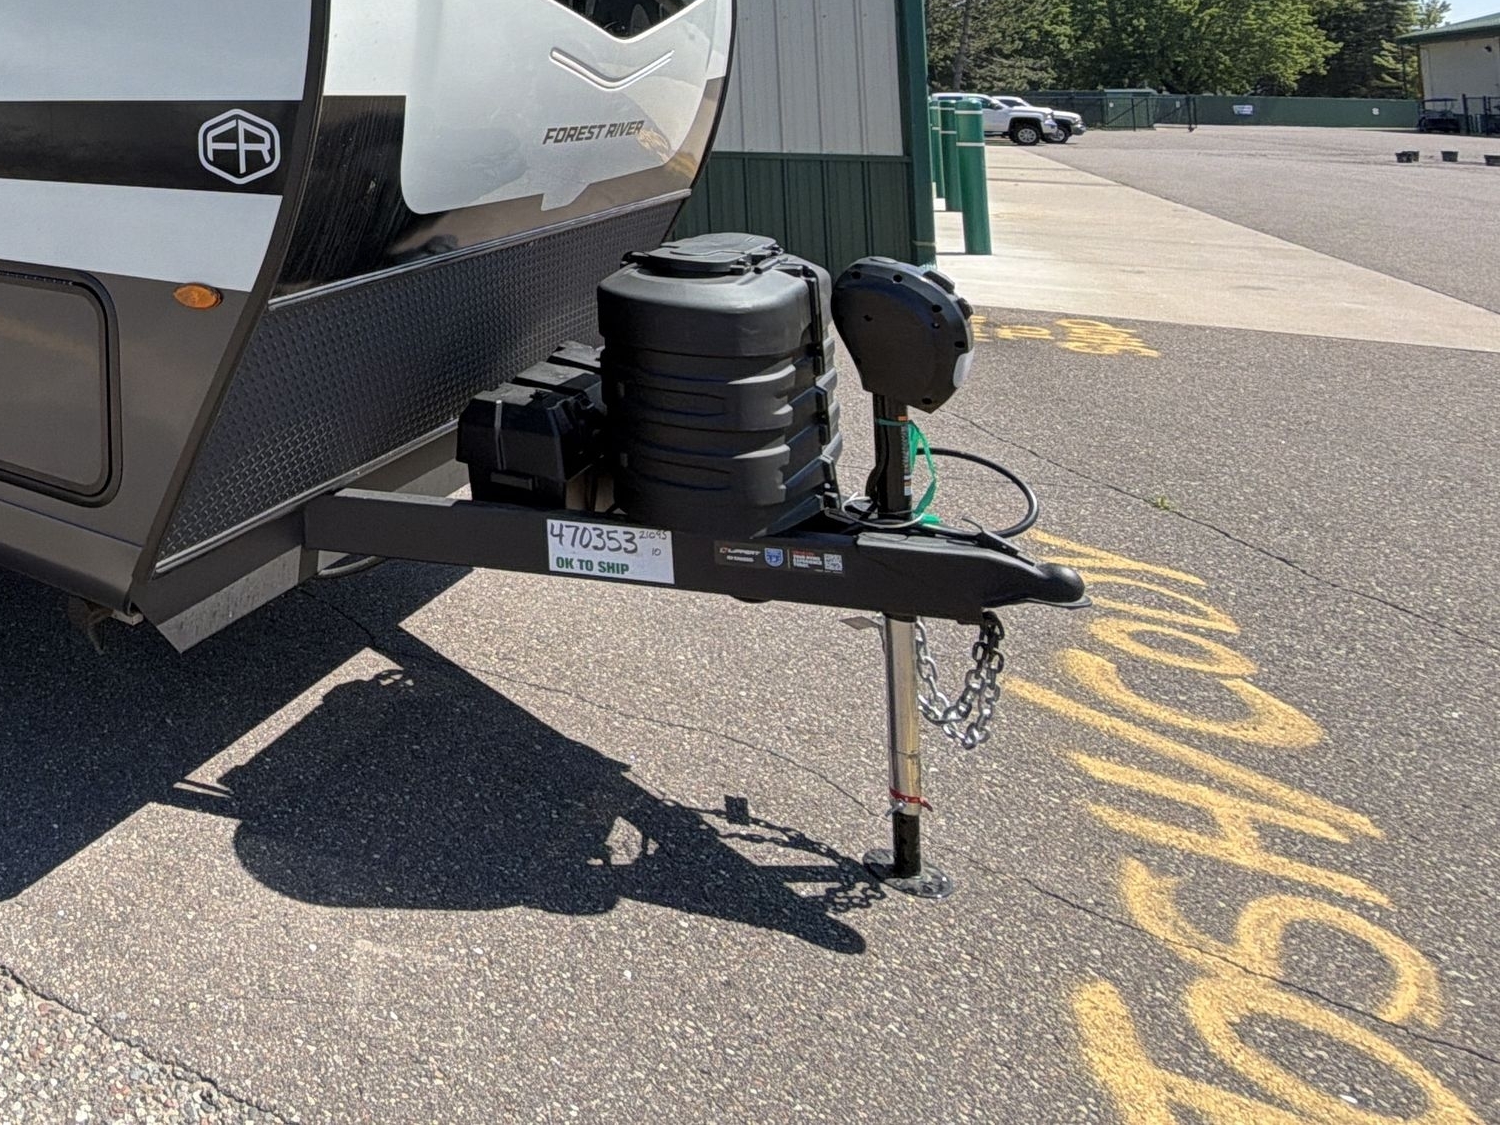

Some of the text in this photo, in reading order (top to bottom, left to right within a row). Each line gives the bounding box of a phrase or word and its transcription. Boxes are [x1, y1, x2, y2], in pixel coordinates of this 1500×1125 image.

[542, 120, 645, 145] FOREST RIVER
[549, 522, 638, 555] 470353
[556, 556, 630, 575] OK TO SHIP
